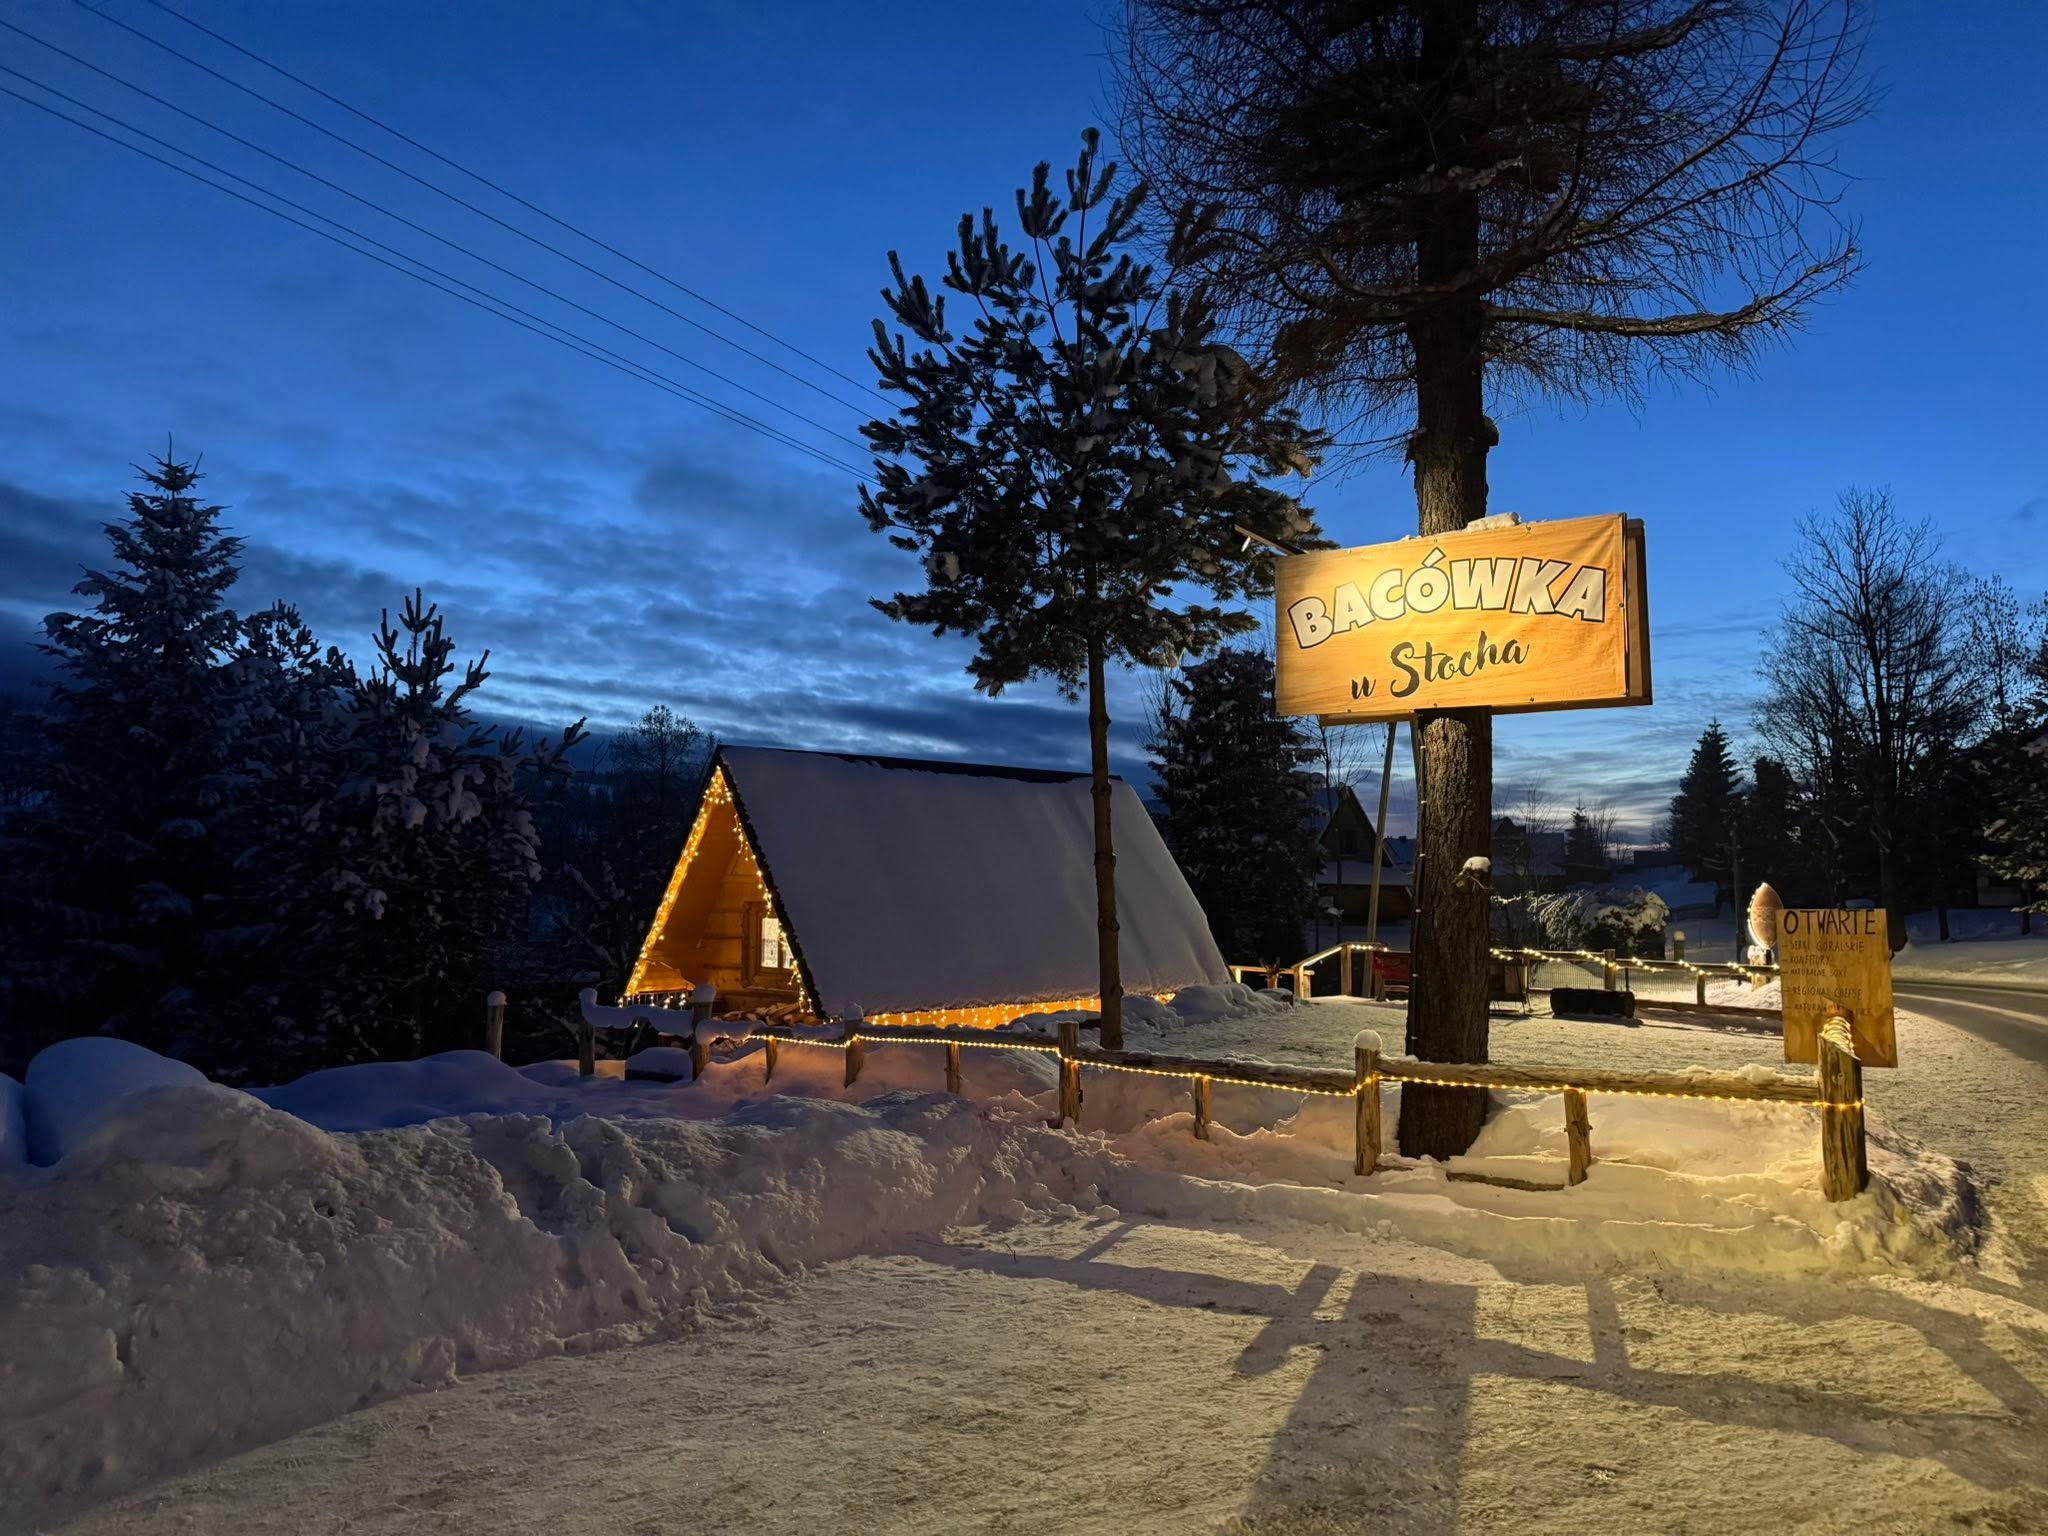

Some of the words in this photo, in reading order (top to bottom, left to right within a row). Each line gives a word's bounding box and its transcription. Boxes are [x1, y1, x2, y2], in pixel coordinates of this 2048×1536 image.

[1288, 547, 1606, 649] BACÓWKA
[1351, 676, 1376, 700] u
[1390, 630, 1530, 698] Stocha
[1784, 909, 1876, 935] OTWARTE
[1793, 986, 1830, 996] REGIONAL
[1834, 988, 1861, 1000] CHEESE
